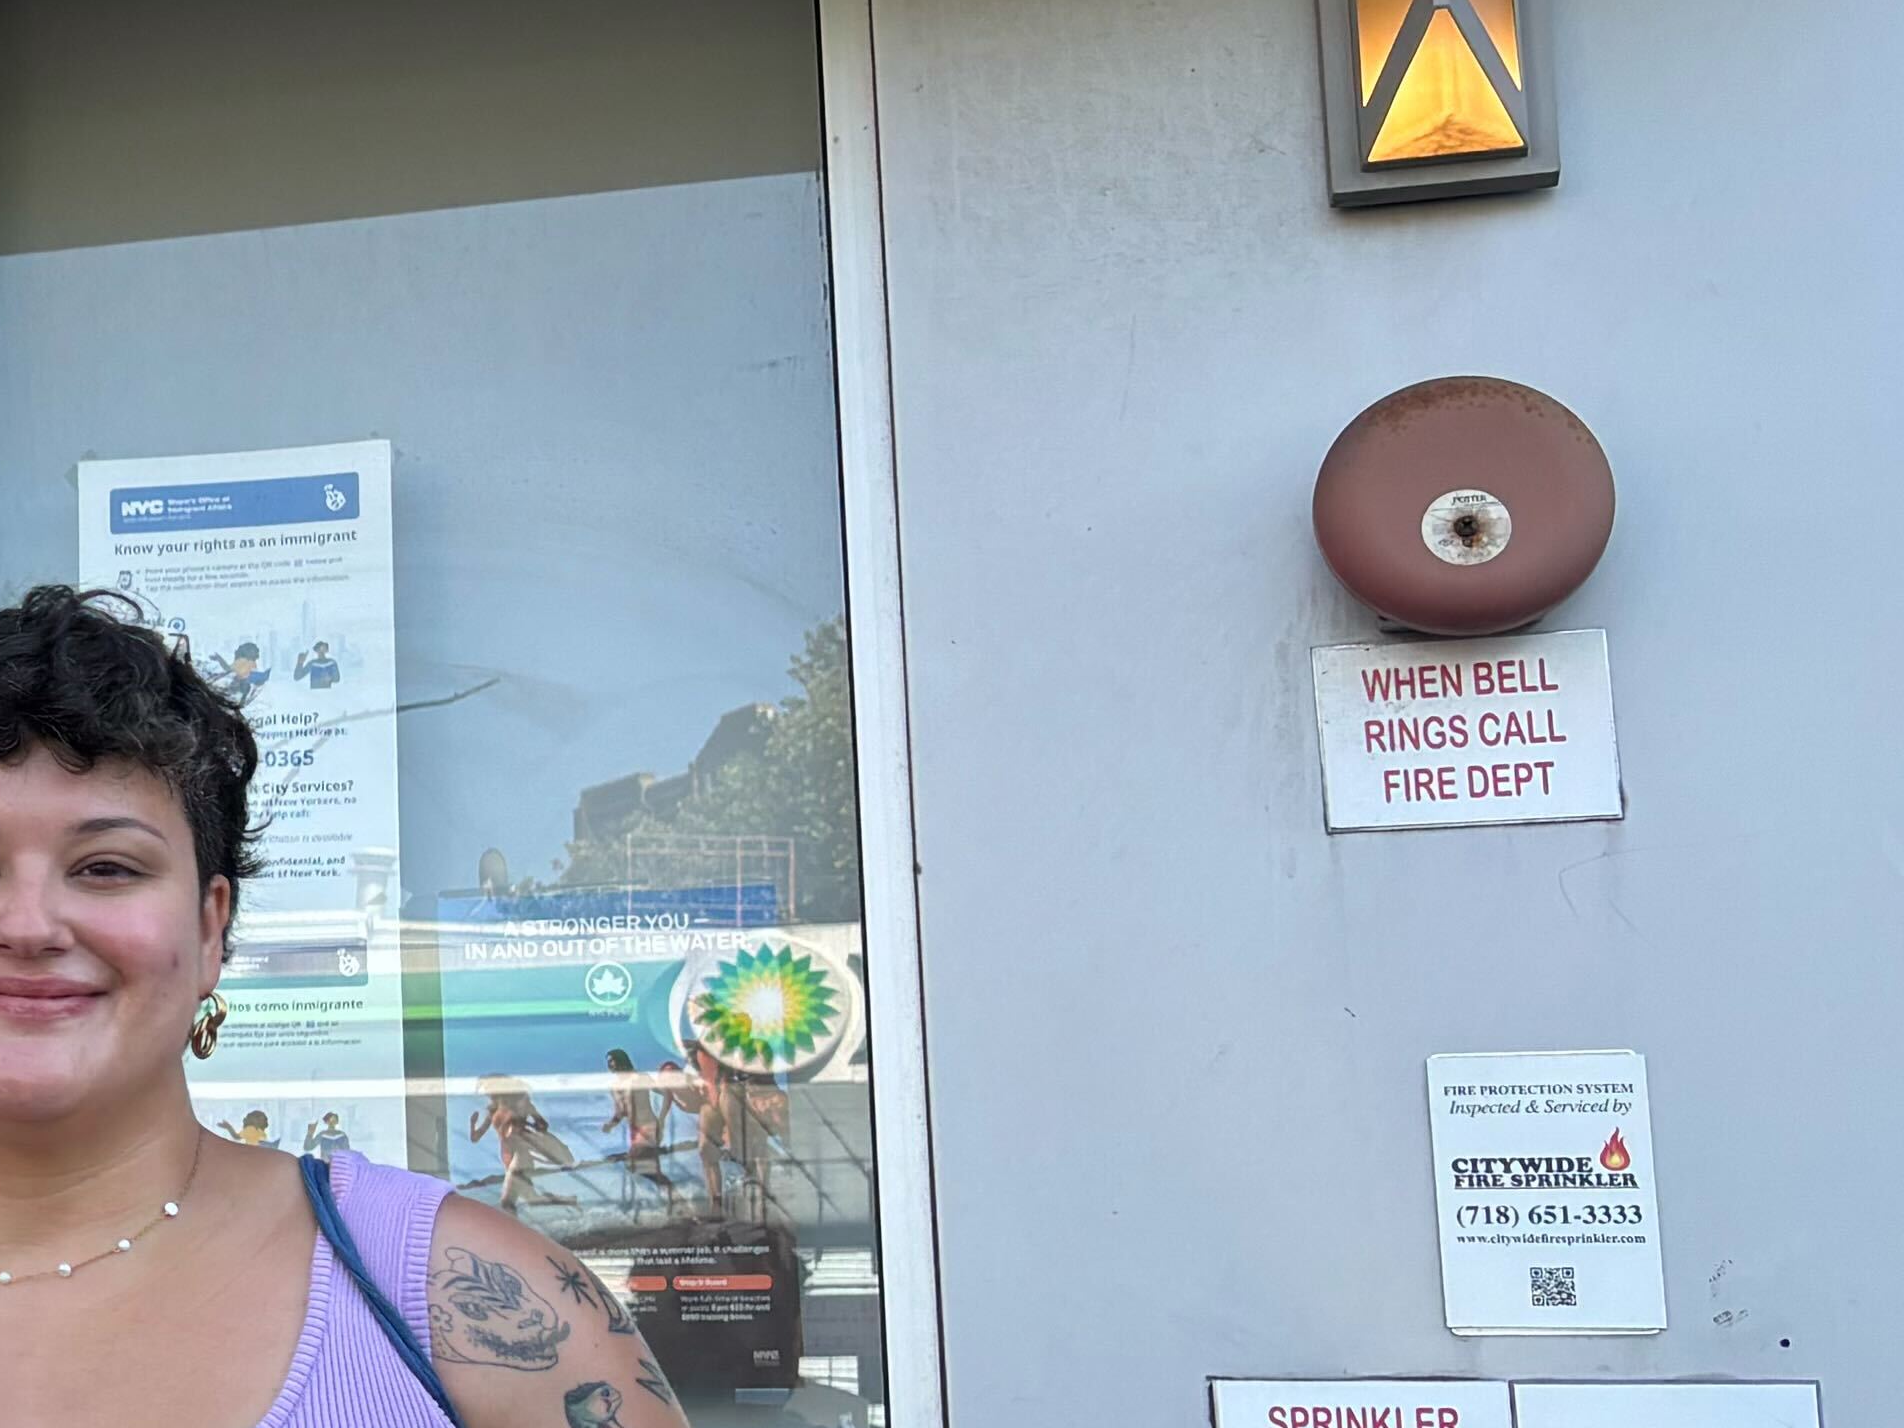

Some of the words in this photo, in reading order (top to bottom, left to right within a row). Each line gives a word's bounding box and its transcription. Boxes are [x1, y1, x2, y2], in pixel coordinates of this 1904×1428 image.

[122, 499, 164, 516] NYC
[114, 542, 153, 556] Know
[157, 541, 190, 558] your
[193, 538, 236, 554] rights
[239, 539, 256, 549] as
[259, 538, 277, 548] an
[280, 530, 358, 547] immigrant
[1361, 663, 1463, 703] WHEN
[1473, 658, 1560, 696] BELL
[248, 714, 277, 727] egal
[281, 712, 319, 725] Help?
[1364, 714, 1469, 753] RINGS
[1478, 709, 1567, 747] CALL
[262, 782, 289, 796] City
[292, 779, 354, 793] Services?
[1383, 766, 1459, 804] FIRE
[1467, 761, 1555, 799] DEPT
[519, 917, 641, 936] STRONGER
[644, 913, 689, 931] YOU
[464, 943, 487, 959] IN
[491, 940, 537, 958] AND
[542, 938, 584, 956] OUT
[589, 936, 620, 955] OF
[622, 935, 666, 953] THE
[669, 931, 752, 951] WATER.
[254, 1002, 289, 1012] como
[292, 999, 364, 1013] inmigrante
[1444, 1085, 1477, 1096] FIRE
[1480, 1084, 1573, 1096] PROTECTION
[1576, 1083, 1634, 1094] SYSTEM
[1449, 1100, 1521, 1117] Inspected
[1525, 1101, 1539, 1114] &
[1544, 1099, 1608, 1114] Serviced
[1613, 1099, 1632, 1116] by
[1451, 1157, 1593, 1174] CITYWIDE
[1454, 1174, 1504, 1188] FIRE
[1511, 1173, 1639, 1188] SPRINKLER
[1456, 1205, 1520, 1228] (718)
[1528, 1204, 1643, 1225] 651-3333
[1456, 1233, 1646, 1247] www.citywidefiresprinkler.com
